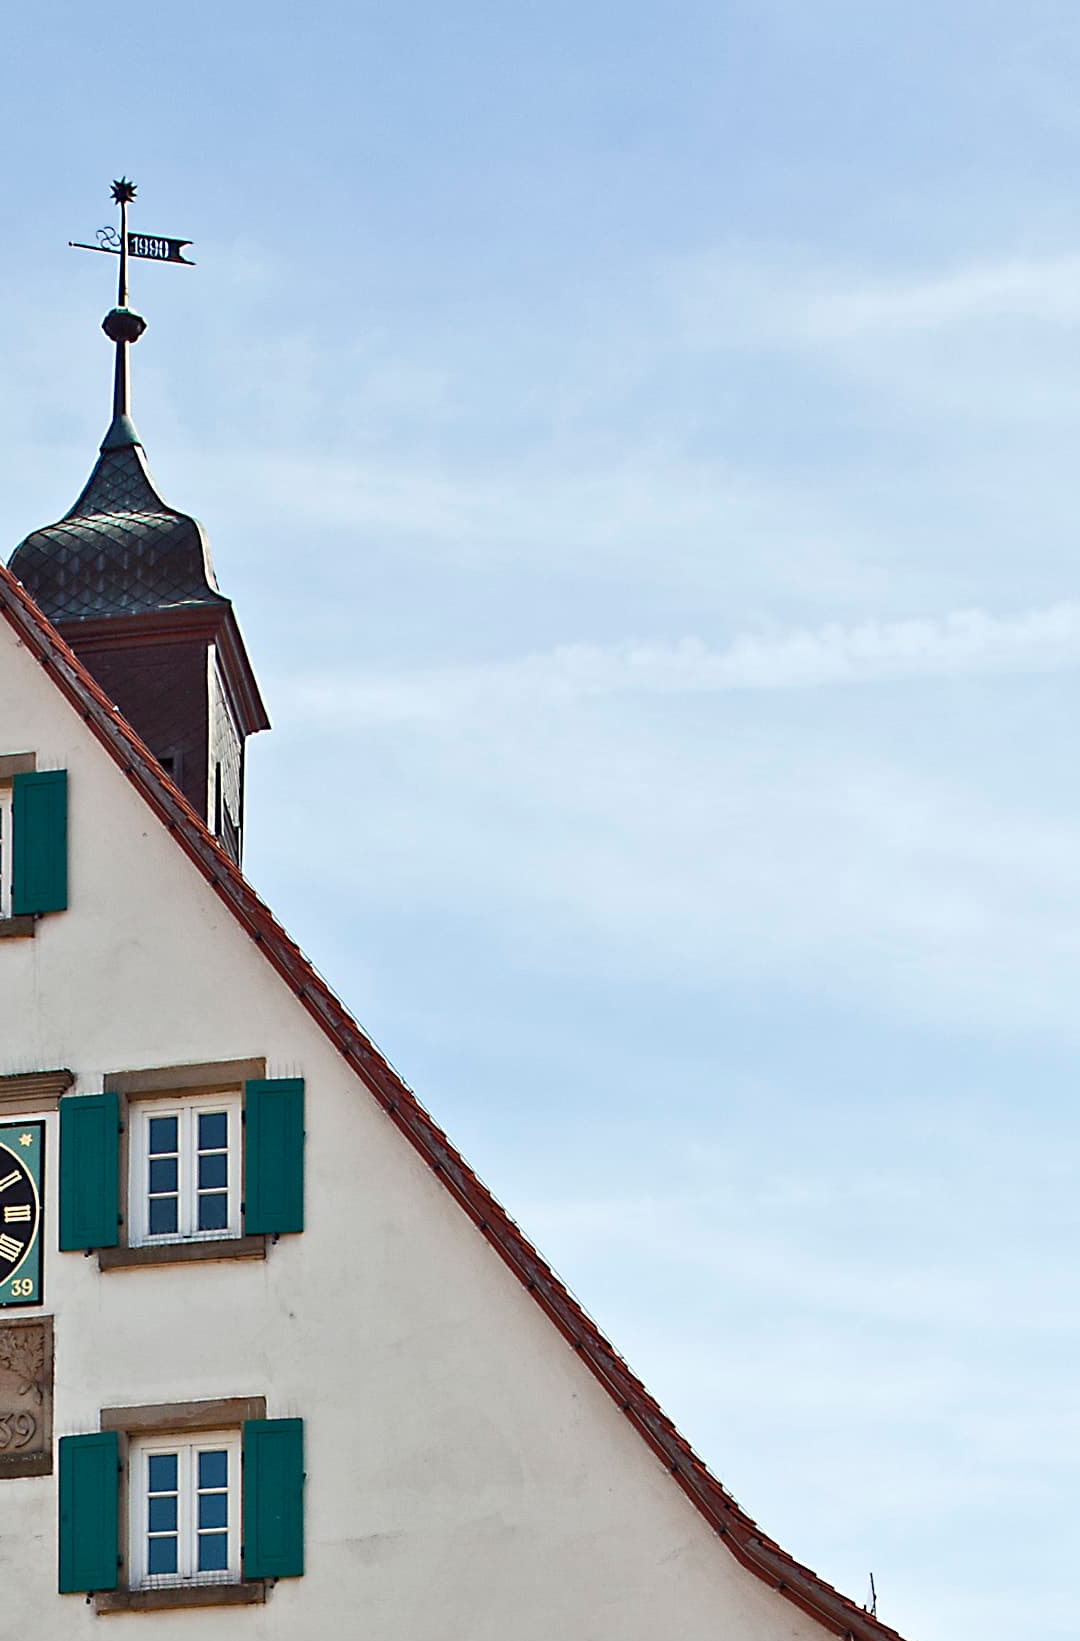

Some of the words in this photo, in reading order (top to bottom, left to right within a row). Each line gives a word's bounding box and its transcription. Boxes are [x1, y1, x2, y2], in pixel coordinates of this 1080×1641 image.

[131, 236, 170, 259] 1990
[3, 1204, 32, 1223] III
[11, 1278, 33, 1297] 39
